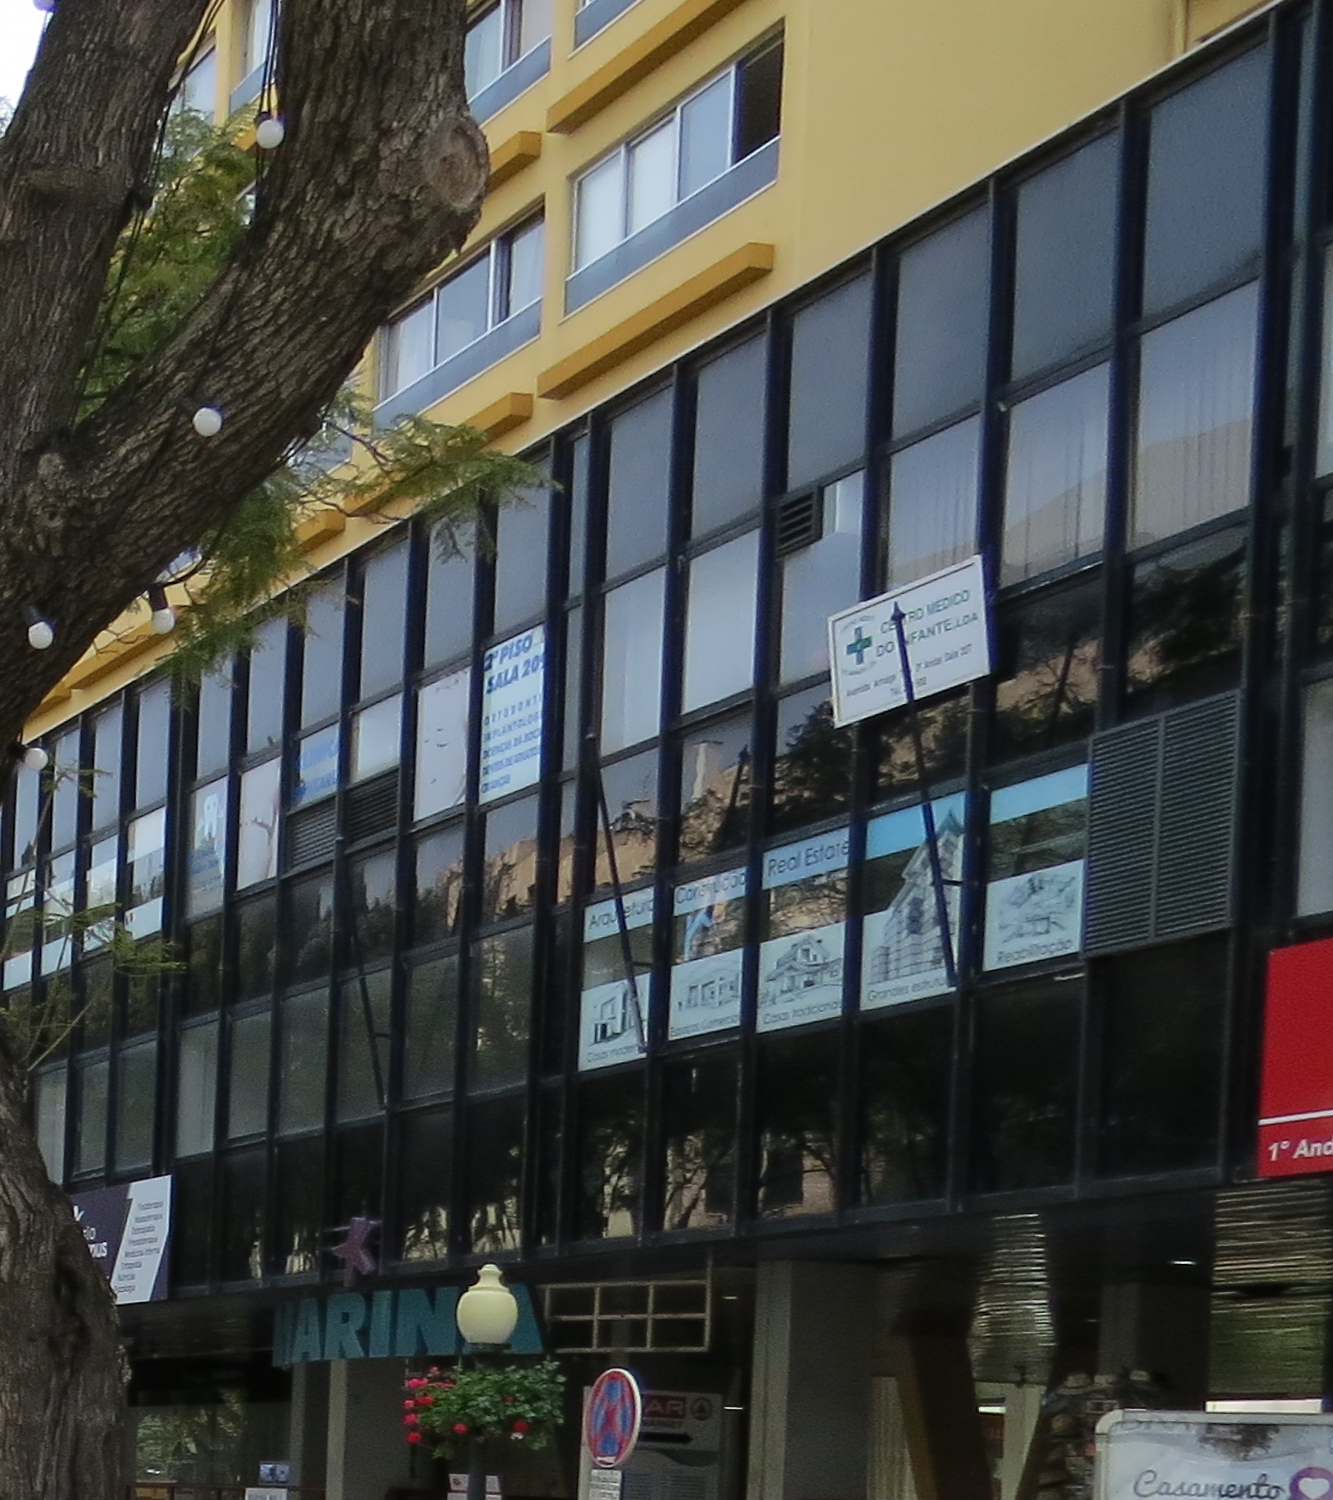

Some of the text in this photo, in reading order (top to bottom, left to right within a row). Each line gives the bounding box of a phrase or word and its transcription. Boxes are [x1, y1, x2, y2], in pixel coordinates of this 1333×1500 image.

[880, 608, 924, 634] CETRO
[499, 636, 533, 665] PISO
[876, 641, 895, 658] DO
[486, 664, 519, 694] SALA
[767, 839, 849, 877] Real Estate
[1134, 1469, 1286, 1499] Casamento
